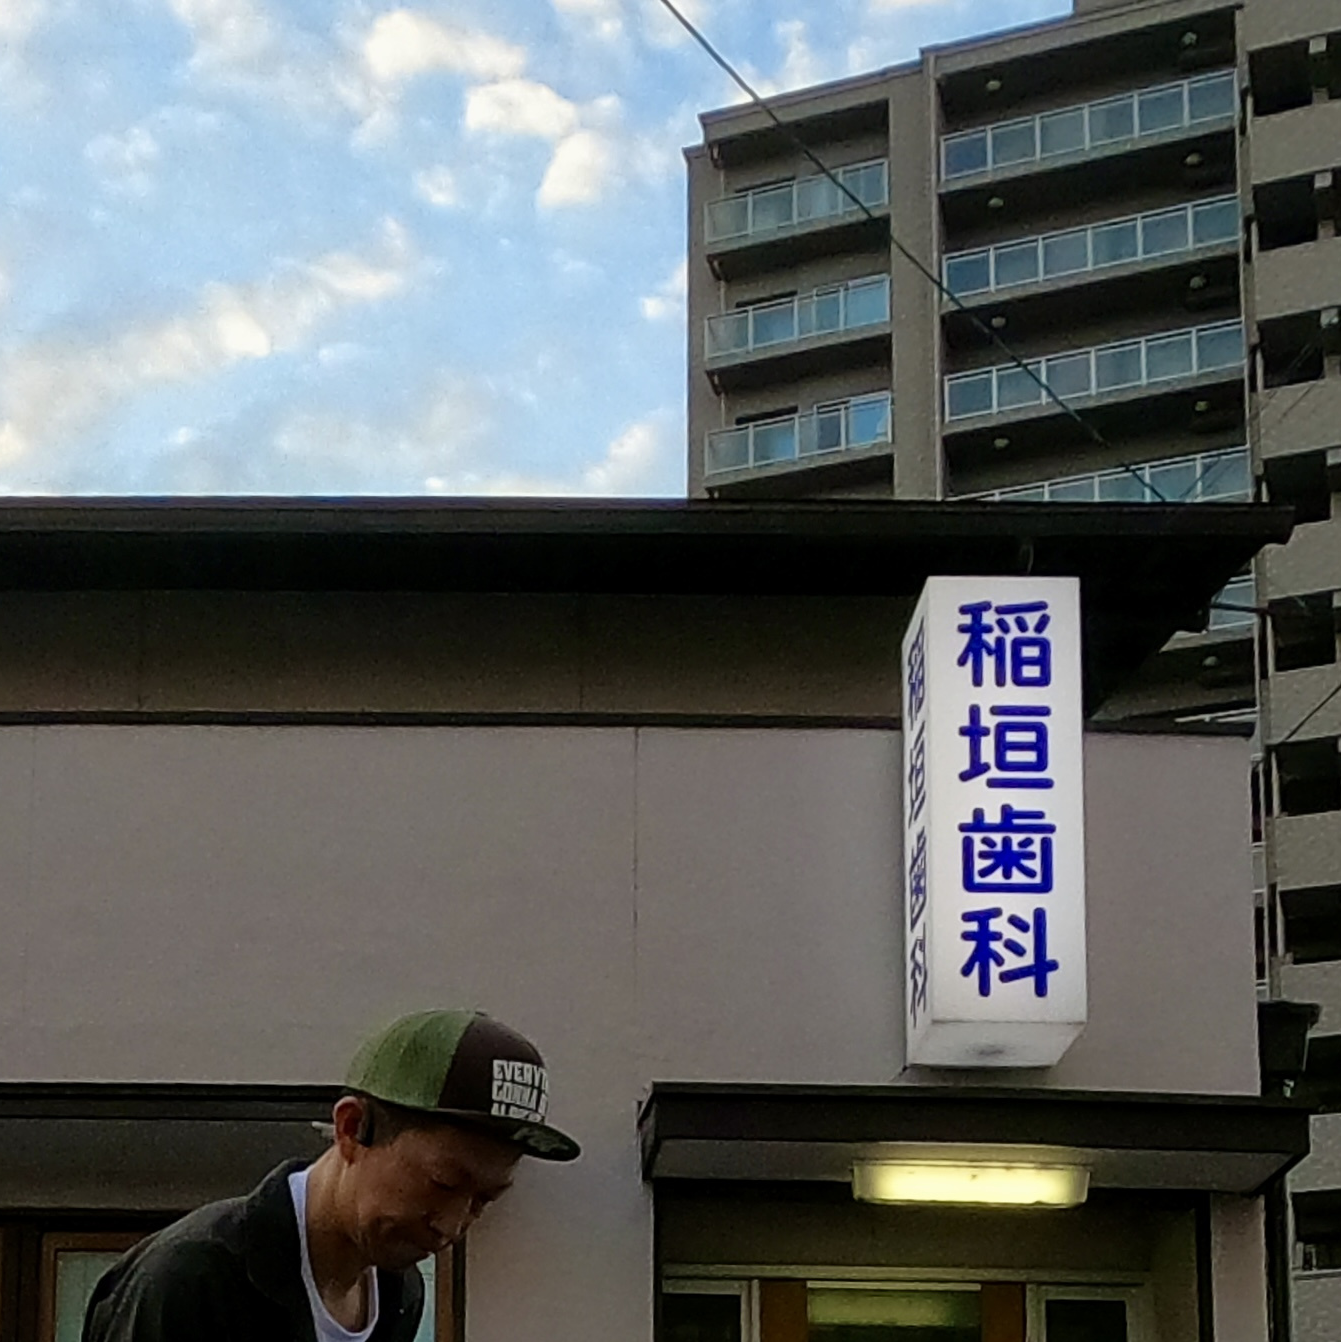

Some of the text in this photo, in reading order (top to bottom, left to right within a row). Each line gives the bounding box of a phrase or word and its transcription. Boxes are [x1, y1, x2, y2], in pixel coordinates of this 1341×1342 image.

[907, 615, 928, 1027] 稲垣歯科
[957, 600, 1059, 997] 稲垣歯科
